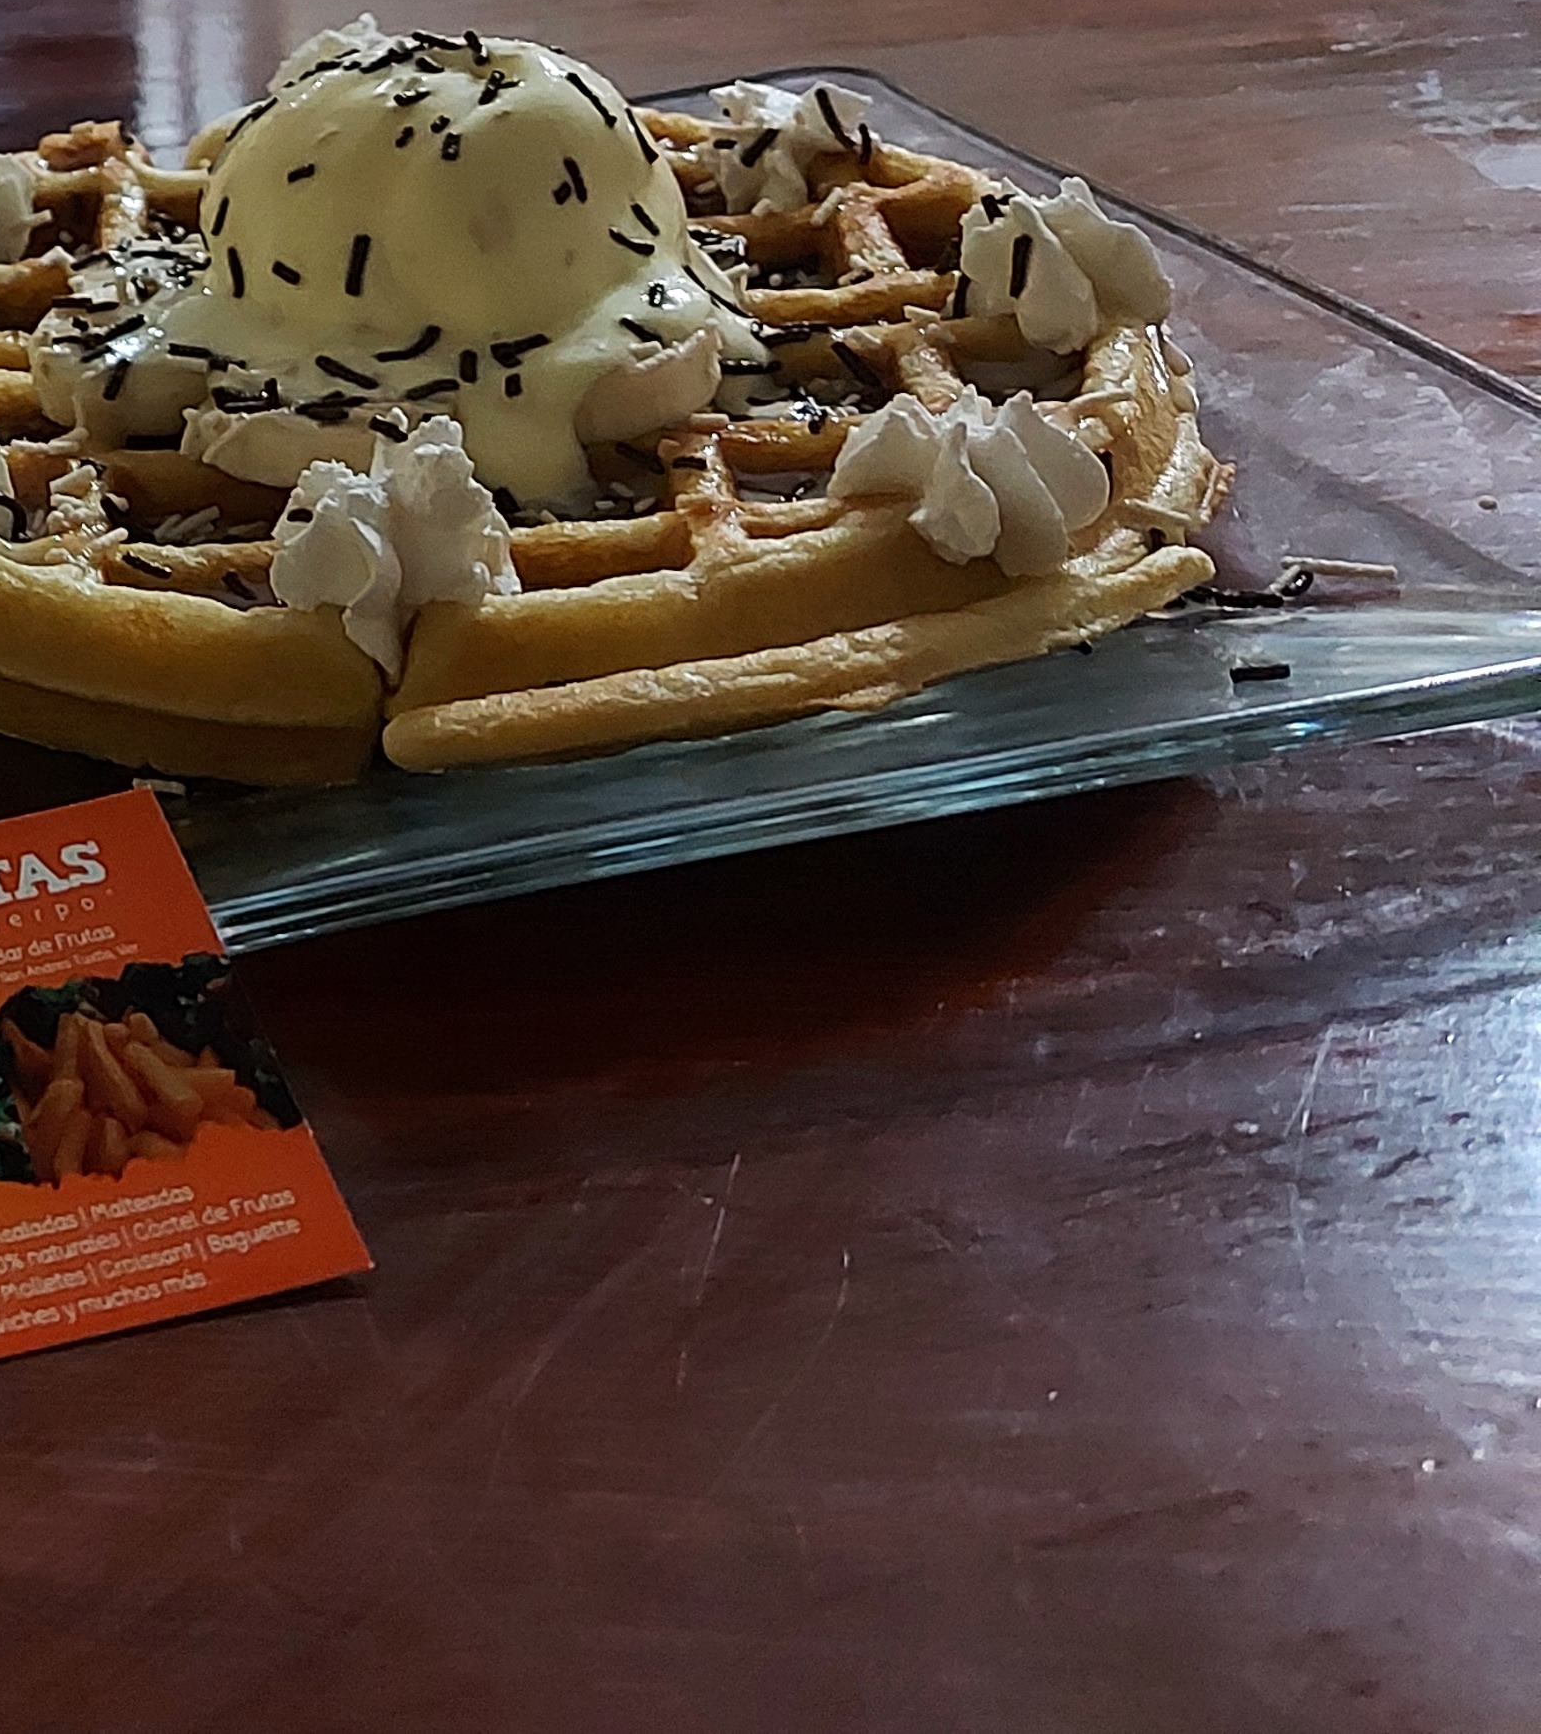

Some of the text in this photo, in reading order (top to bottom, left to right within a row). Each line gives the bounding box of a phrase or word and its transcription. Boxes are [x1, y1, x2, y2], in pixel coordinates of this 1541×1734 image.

[27, 939, 53, 956] de
[53, 925, 115, 950] Frutas
[89, 1185, 194, 1222] Malteadas
[201, 1205, 230, 1225] de
[228, 1189, 295, 1217] Frutas
[60, 1302, 76, 1324] y
[76, 1282, 162, 1313] muchos
